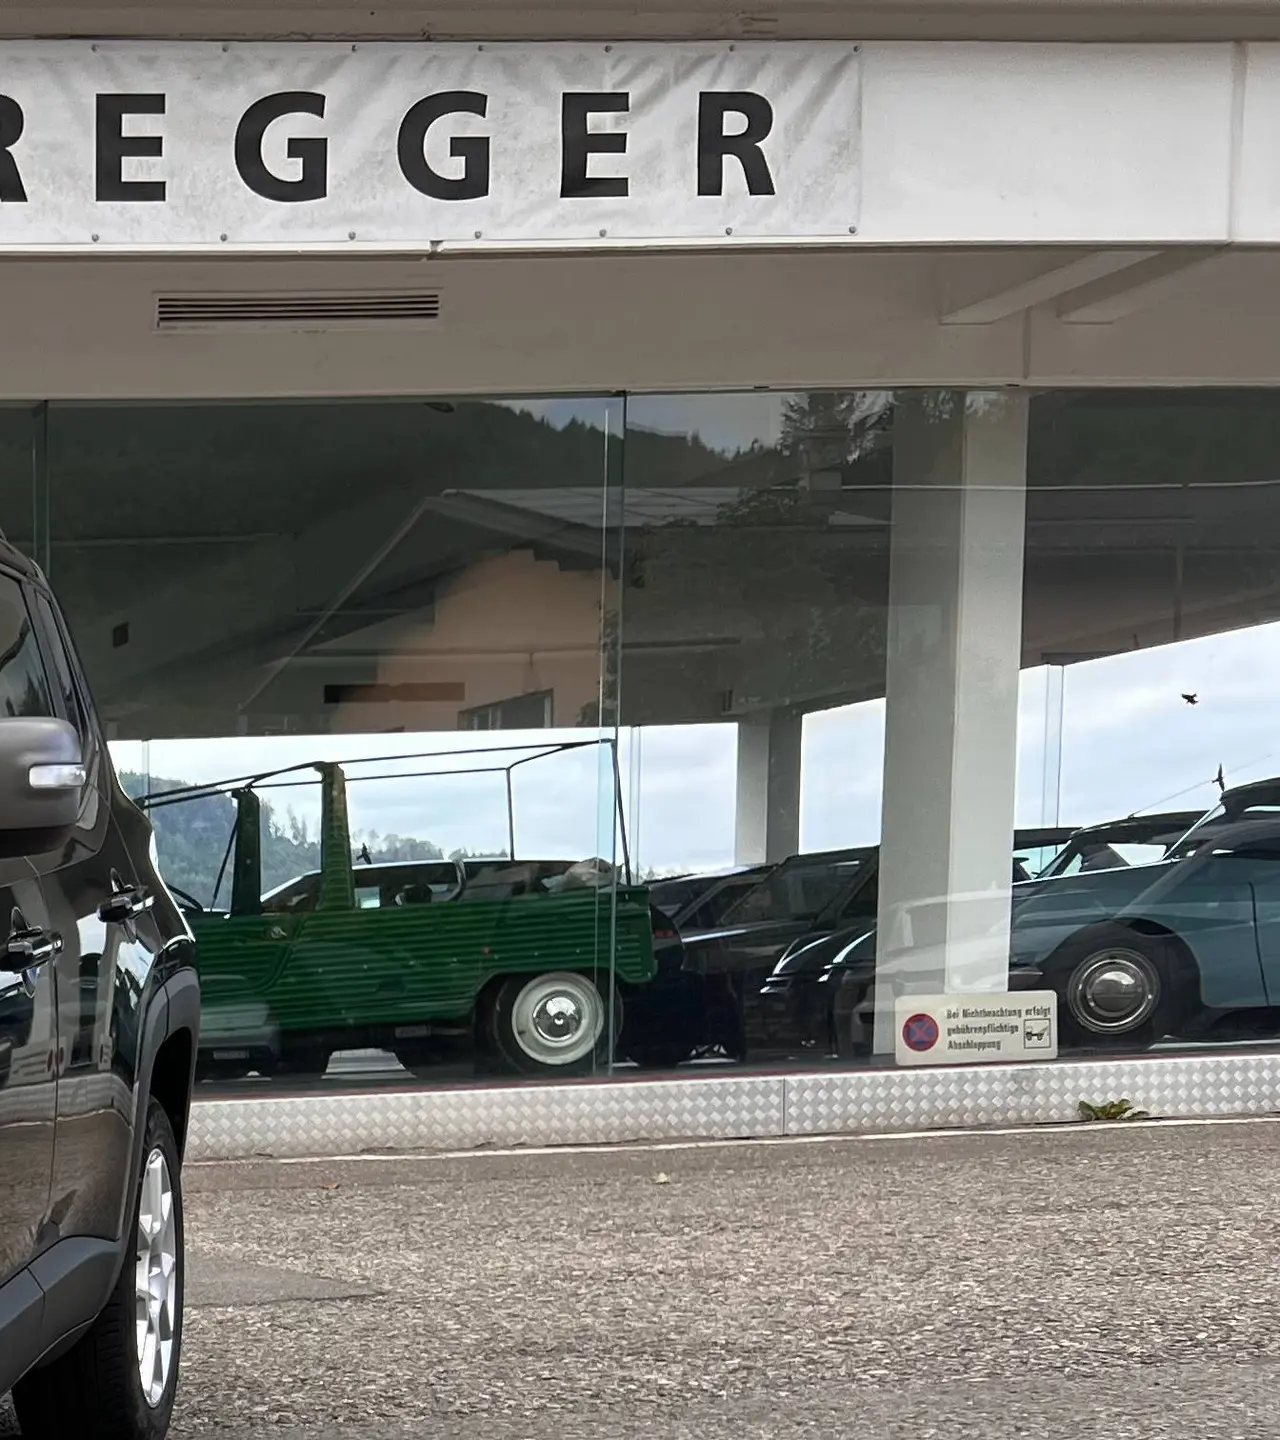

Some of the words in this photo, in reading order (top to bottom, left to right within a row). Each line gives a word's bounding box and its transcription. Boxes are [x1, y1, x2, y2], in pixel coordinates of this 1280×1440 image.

[946, 1008, 960, 1020] Bei
[962, 1007, 1022, 1019] Nichtbeachtung
[1025, 1005, 1051, 1018] erfolgt
[947, 1023, 1019, 1037] gebührenpflichtige
[947, 1040, 1002, 1052] Abschleppung
